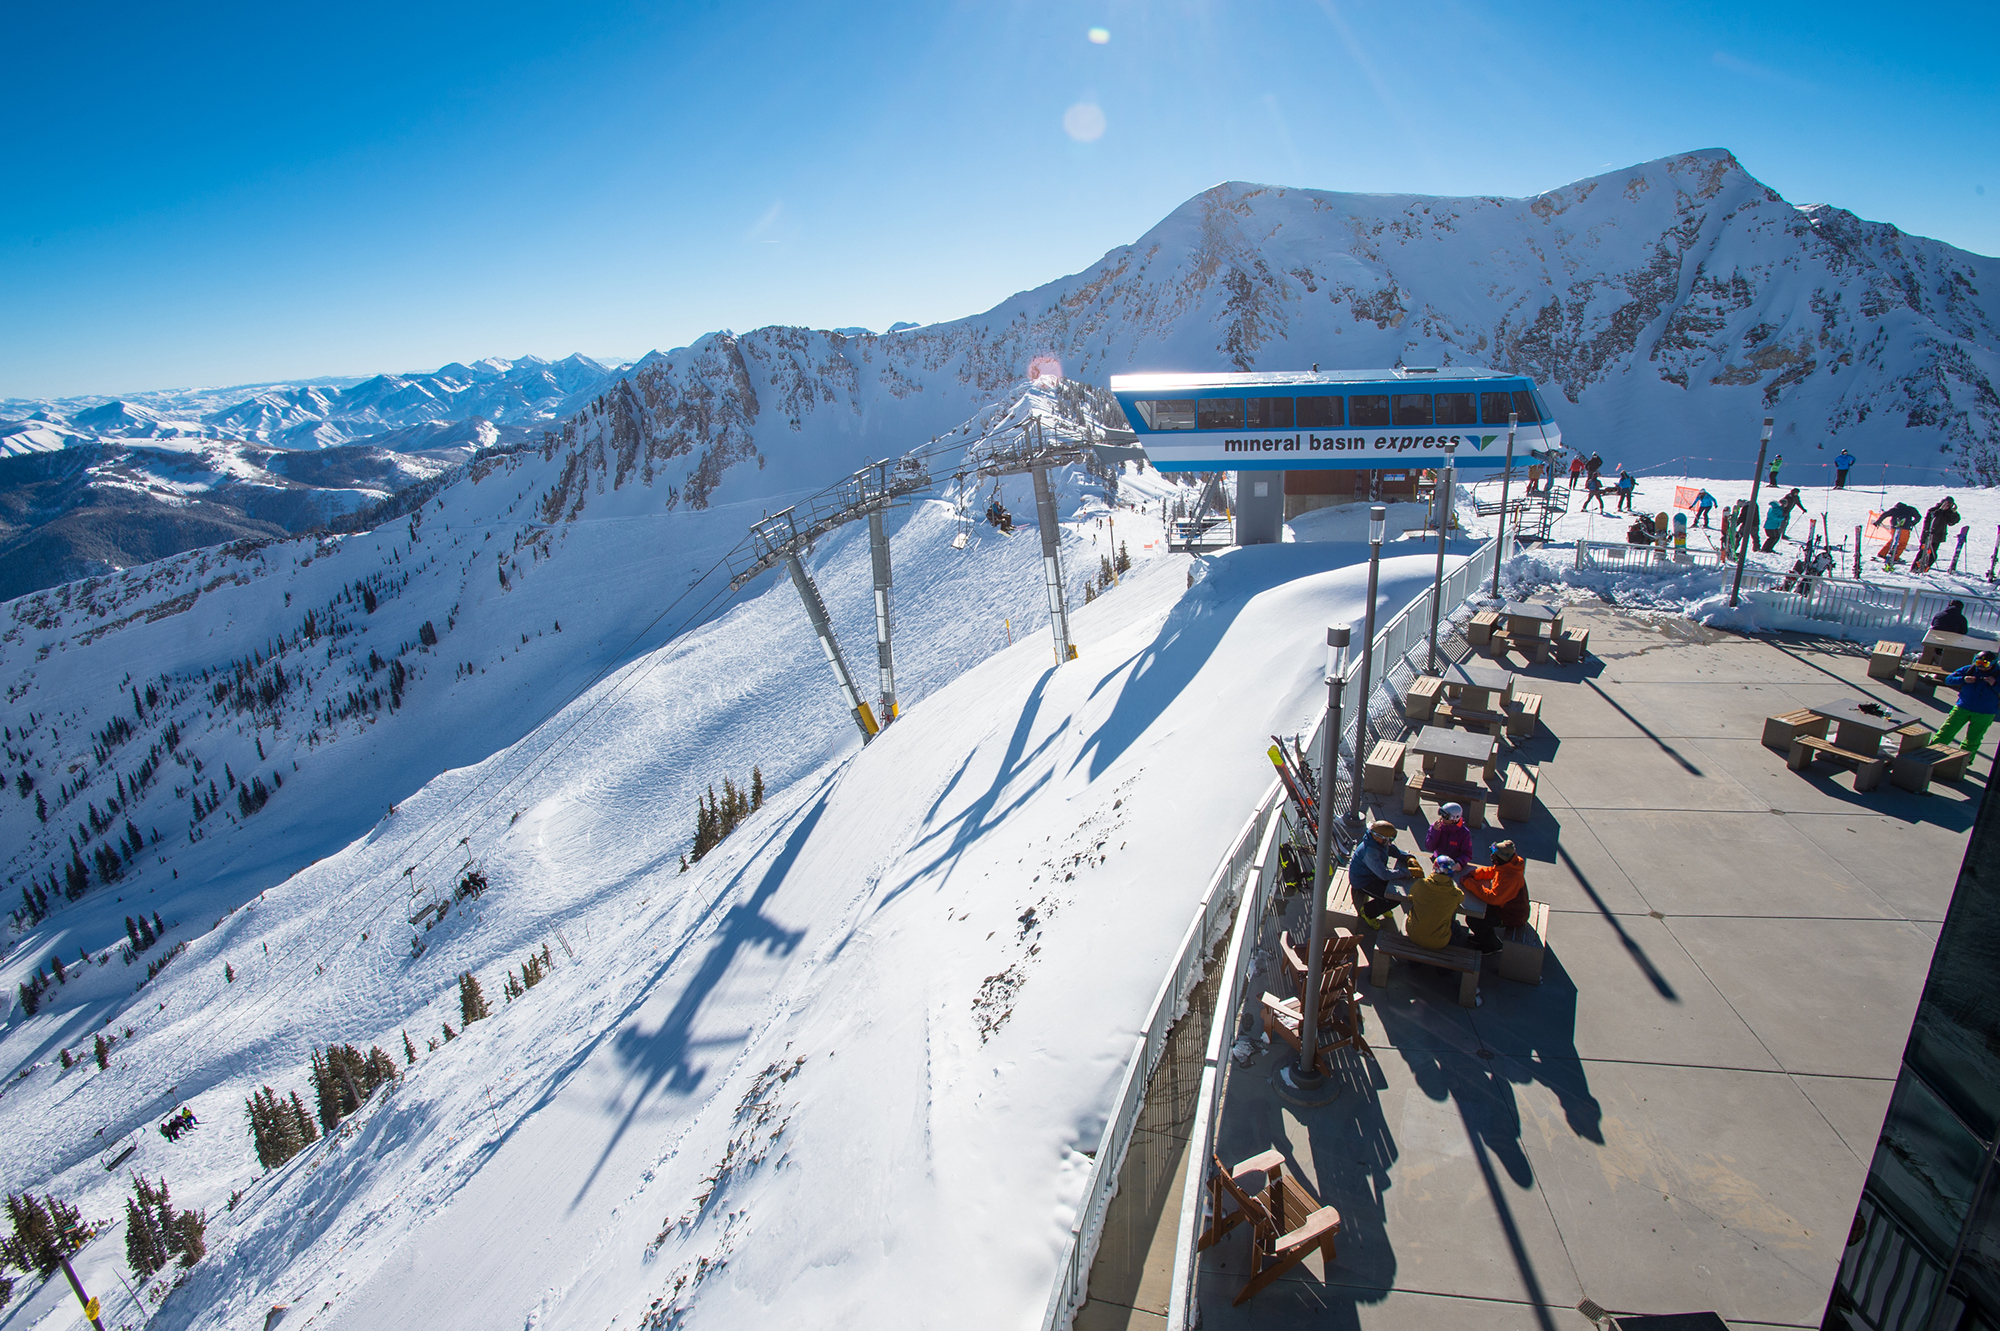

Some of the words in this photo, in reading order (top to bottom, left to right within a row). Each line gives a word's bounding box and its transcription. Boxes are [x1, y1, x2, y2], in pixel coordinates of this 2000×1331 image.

[1224, 434, 1300, 452] mineral
[1309, 434, 1365, 451] basin
[1374, 435, 1460, 452] express
